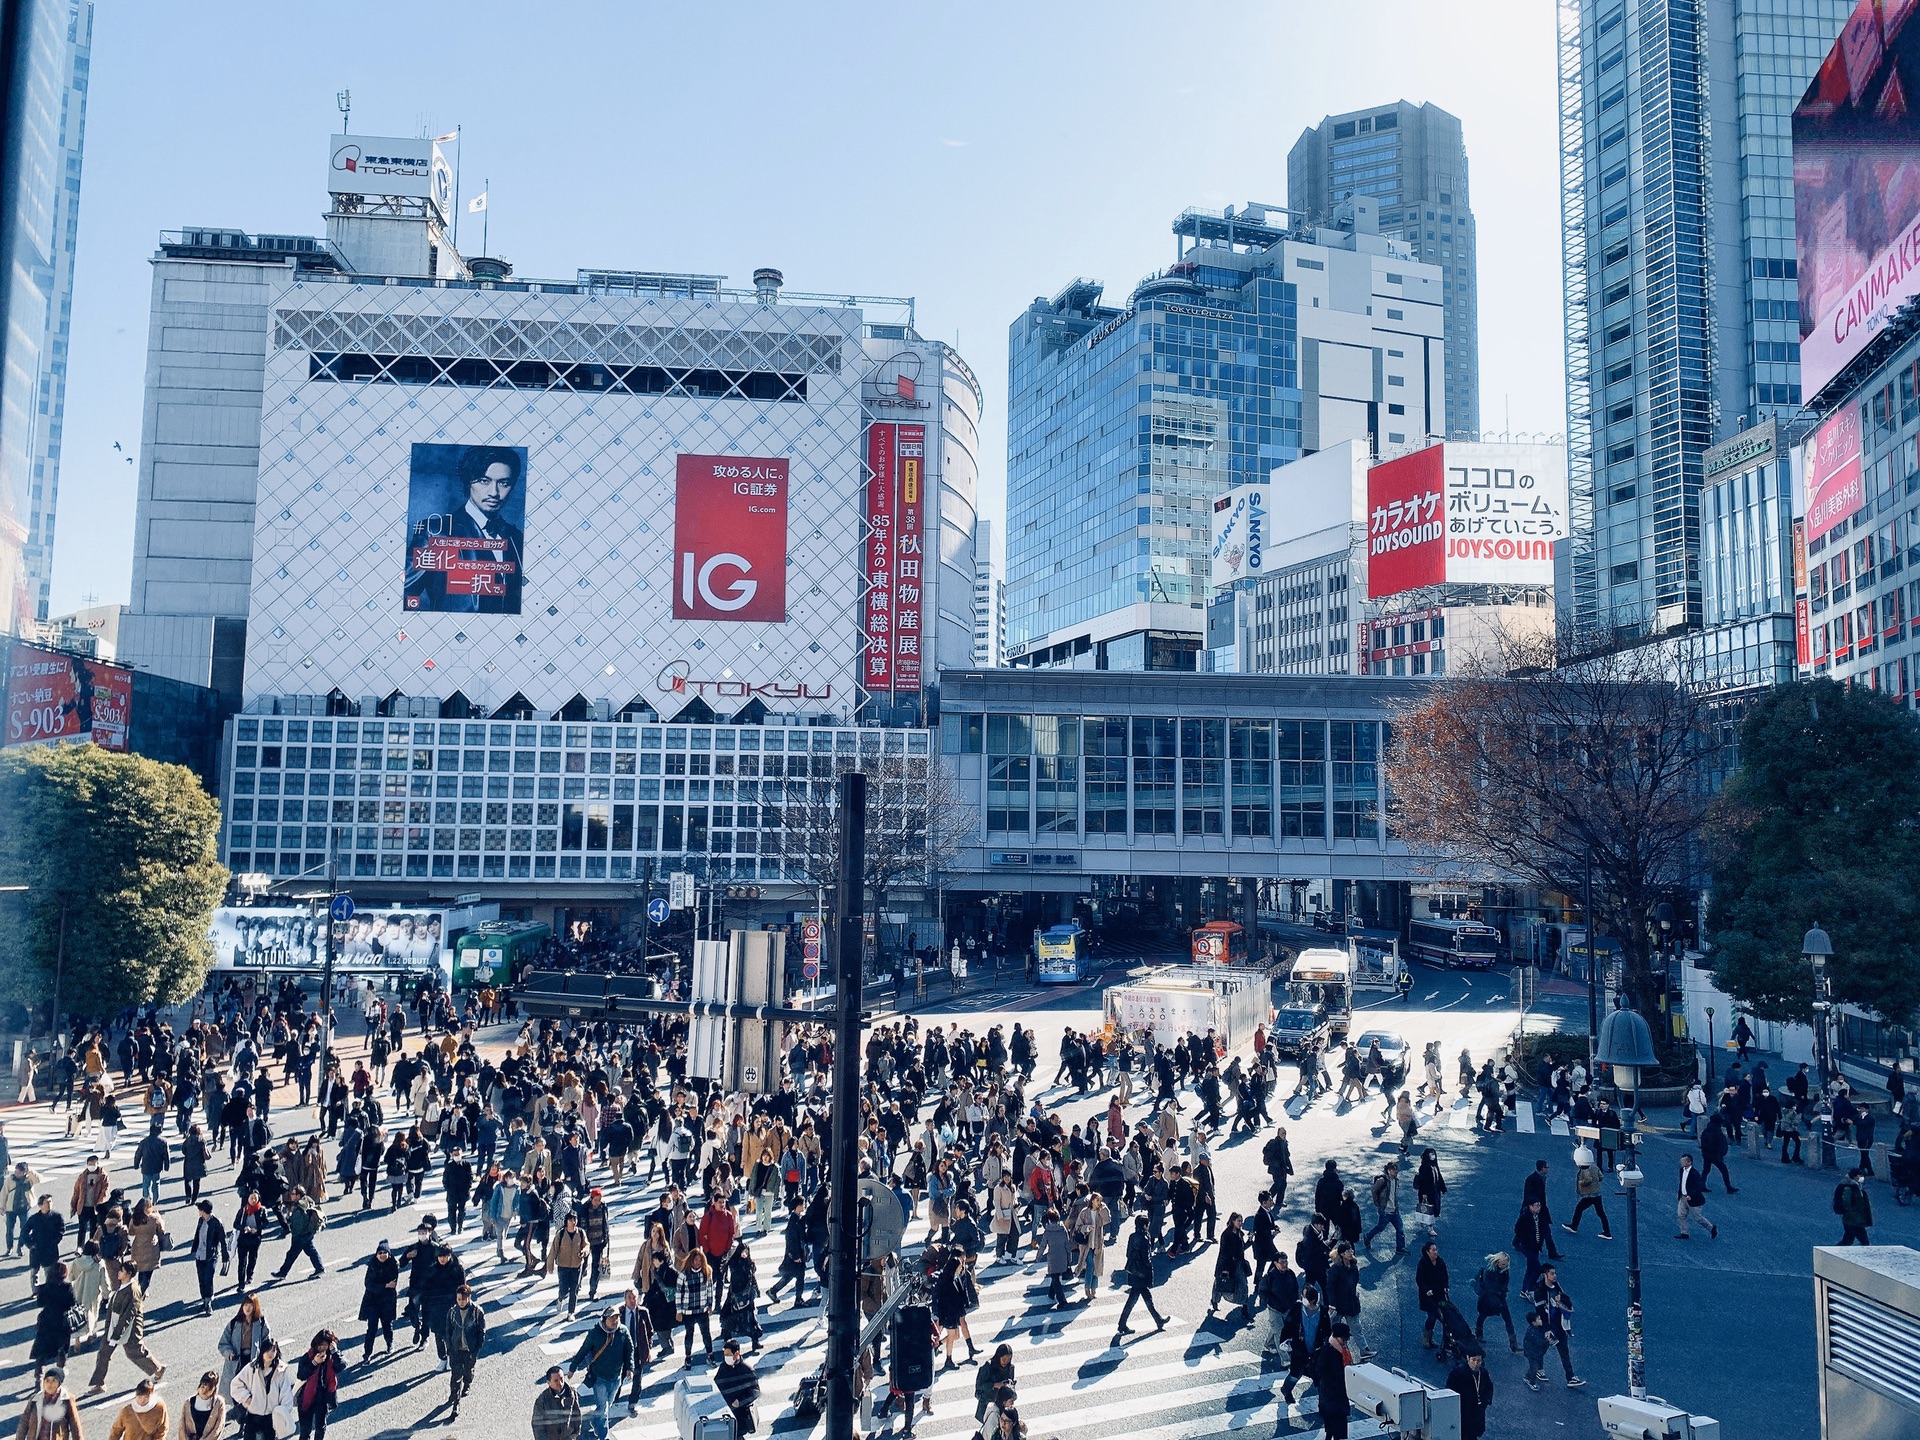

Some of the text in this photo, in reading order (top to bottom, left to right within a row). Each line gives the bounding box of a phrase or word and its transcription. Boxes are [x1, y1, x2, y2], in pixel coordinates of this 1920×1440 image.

[359, 165, 429, 177] TOKYU
[364, 155, 428, 167] 東急東横店
[1165, 303, 1234, 320] TOKYU PLAZA
[1866, 303, 1889, 335] TOKYO
[867, 399, 931, 410] TOKYU
[1826, 412, 1857, 448] 品川スキン
[1828, 434, 1854, 468] クリニック
[713, 465, 784, 480] 攻める人に。
[1449, 467, 1535, 490] ココロの
[733, 482, 778, 497] IG証券
[748, 505, 776, 514] IG.com
[1371, 490, 1440, 535] カラオケ
[1449, 490, 1561, 517] ボリューム、
[1814, 477, 1860, 529] 品川美容外科
[413, 512, 453, 536] #01
[905, 508, 916, 530] 第38回
[1213, 497, 1245, 559] SANKYO
[1249, 492, 1267, 568] SANKYO
[1449, 516, 1562, 536] あげていこう。
[432, 539, 506, 549] 人生に迷ったら、自分が
[1371, 520, 1443, 557] JOYSOUND
[415, 549, 514, 572] 進化できるかどうかの、
[450, 573, 504, 594] 一択で。
[682, 552, 758, 612] IG
[407, 599, 419, 608] IG
[869, 514, 891, 677] 85年分の東横総決算
[899, 534, 922, 655] 秋田物産展
[1374, 616, 1398, 629] カラオケ
[1706, 663, 1745, 678] SHIBUYA
[687, 681, 830, 699] TOKYU
[1687, 670, 1771, 694] MARK CITY
[10, 688, 53, 707] すごい納豆
[10, 705, 65, 739] S-903
[94, 705, 120, 724] S-903
[675, 875, 683, 907] 渋谷駅前
[352, 952, 384, 965] Man
[402, 957, 429, 965] DEBUT!
[1606, 1422, 1618, 1430] HD
